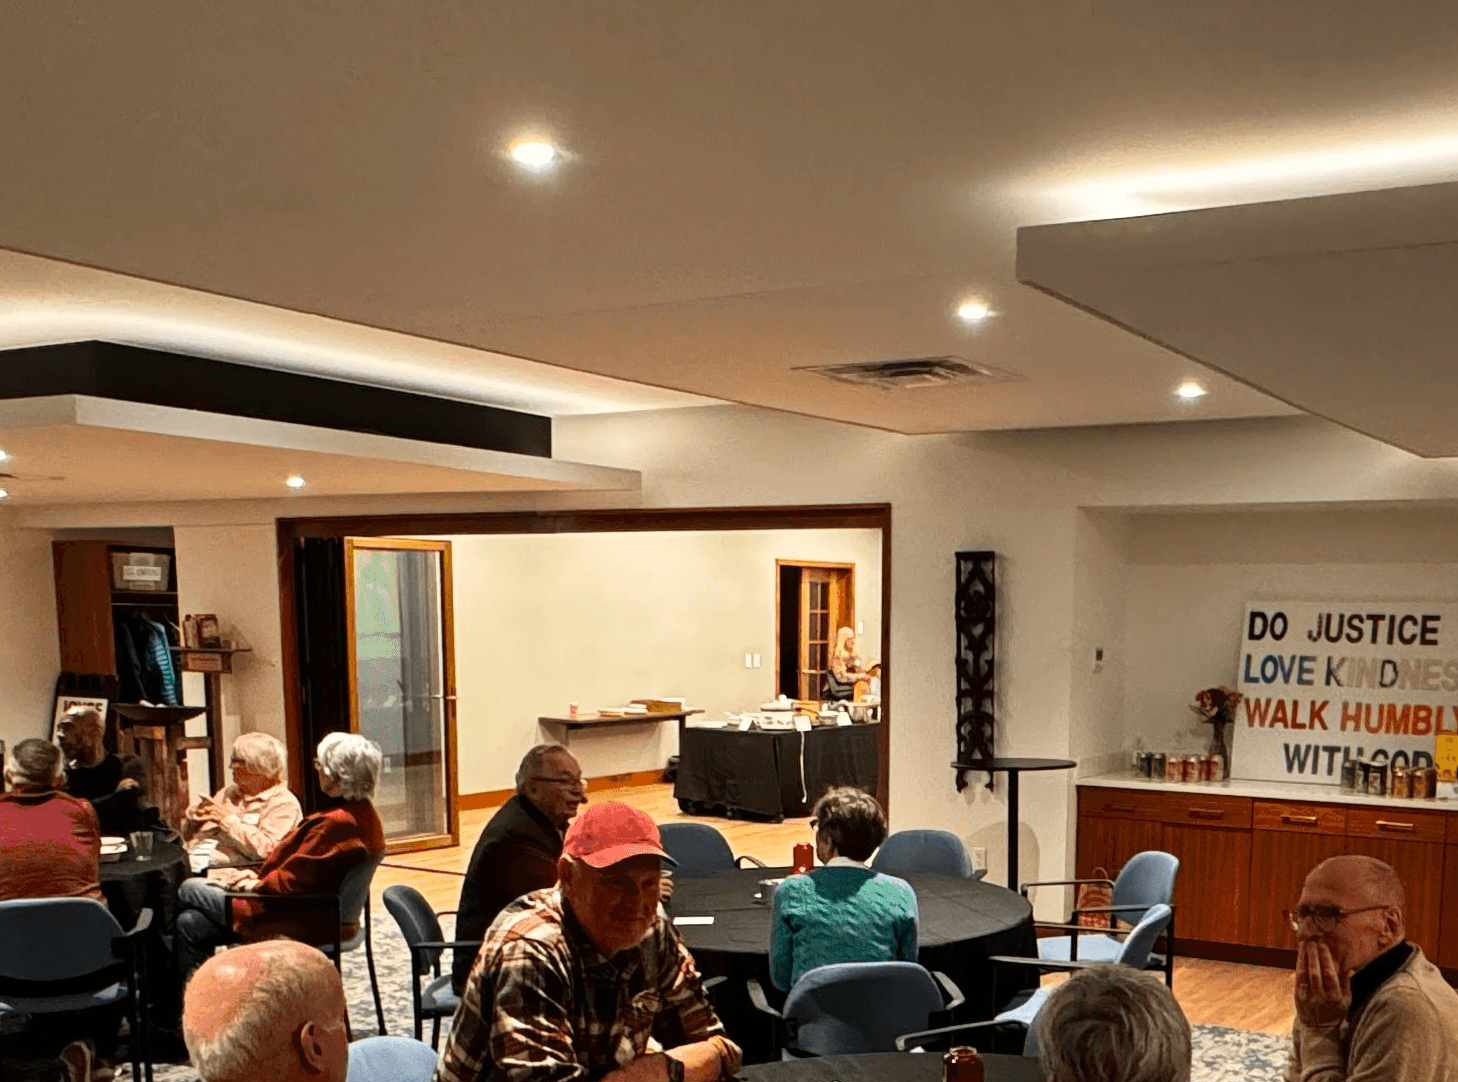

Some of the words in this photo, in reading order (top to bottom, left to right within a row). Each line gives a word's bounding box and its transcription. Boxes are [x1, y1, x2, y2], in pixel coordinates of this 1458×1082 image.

[1248, 611, 1288, 641] DO
[1308, 612, 1441, 646] JUSTICE
[1243, 654, 1318, 686] LOVE
[1244, 697, 1330, 731] WALK
